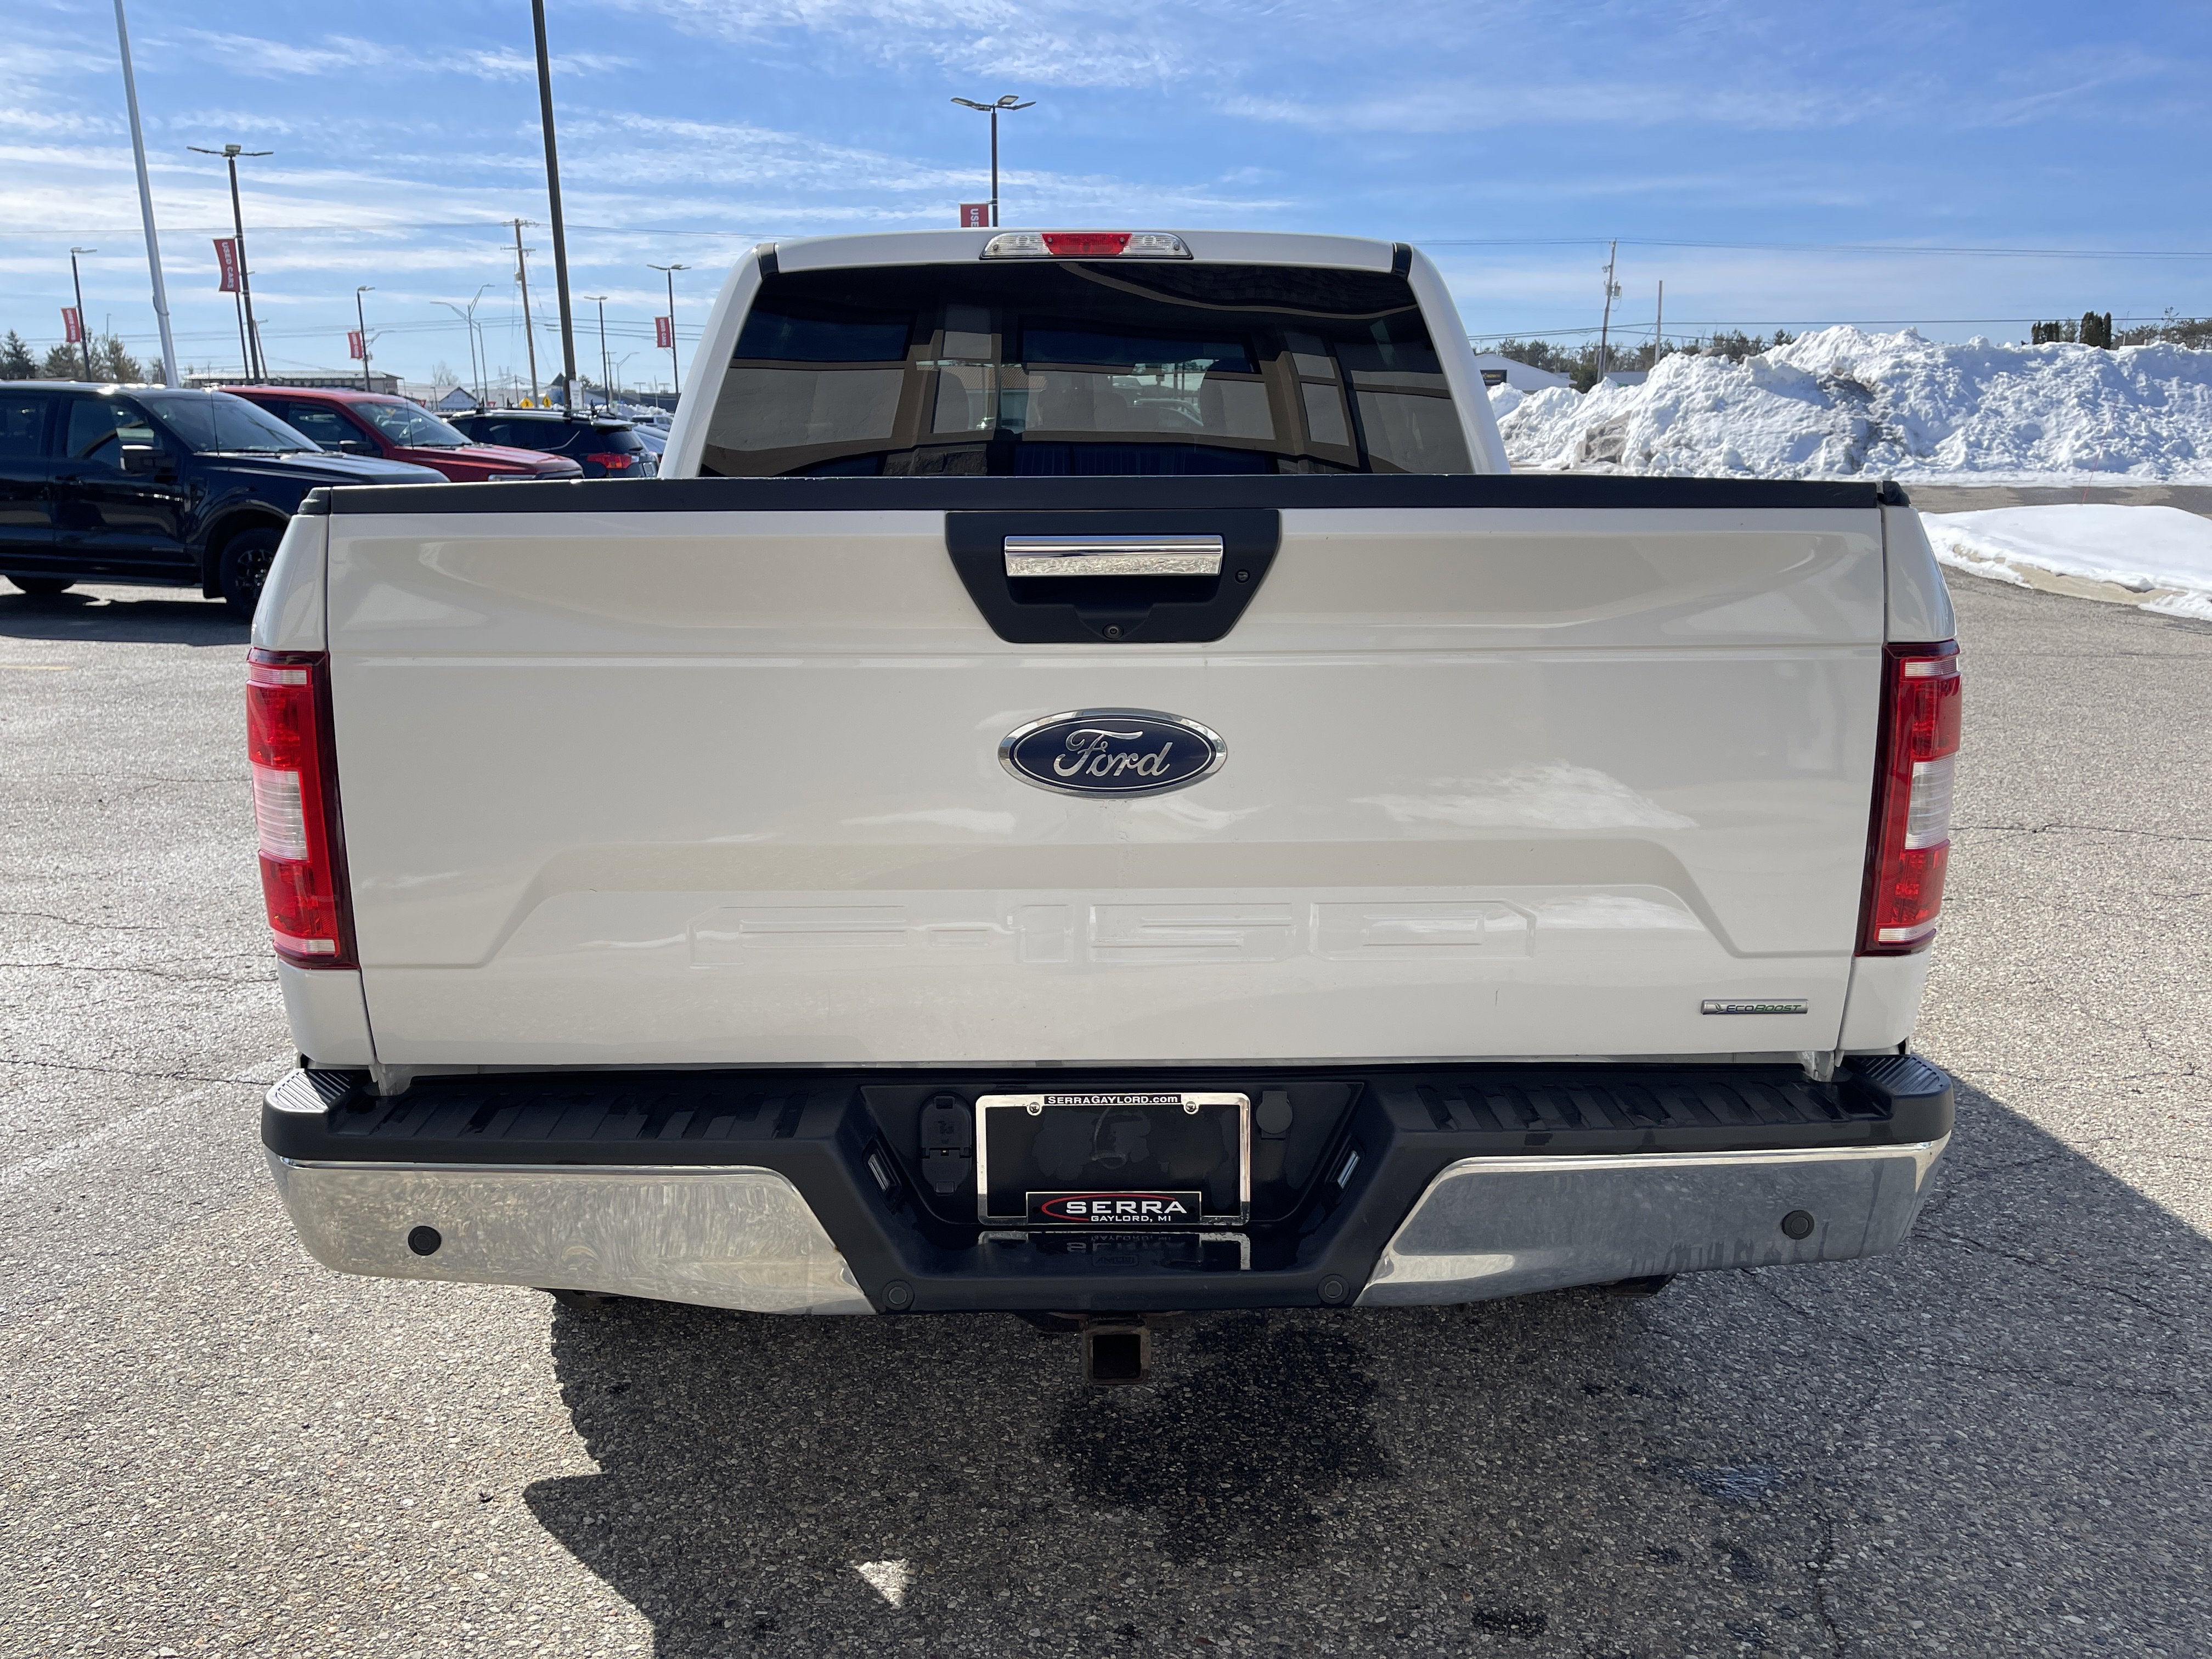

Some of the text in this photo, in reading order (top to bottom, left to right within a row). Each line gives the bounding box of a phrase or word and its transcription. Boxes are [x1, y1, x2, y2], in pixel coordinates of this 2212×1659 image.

[970, 208, 979, 227] USE
[222, 241, 232, 264] USED
[1053, 729, 1173, 777] Ford
[1726, 1004, 1802, 1013] ECOBOOST
[1048, 1096, 1178, 1104] SERRAGAYLORD.com
[1066, 1201, 1187, 1214] SERRA
